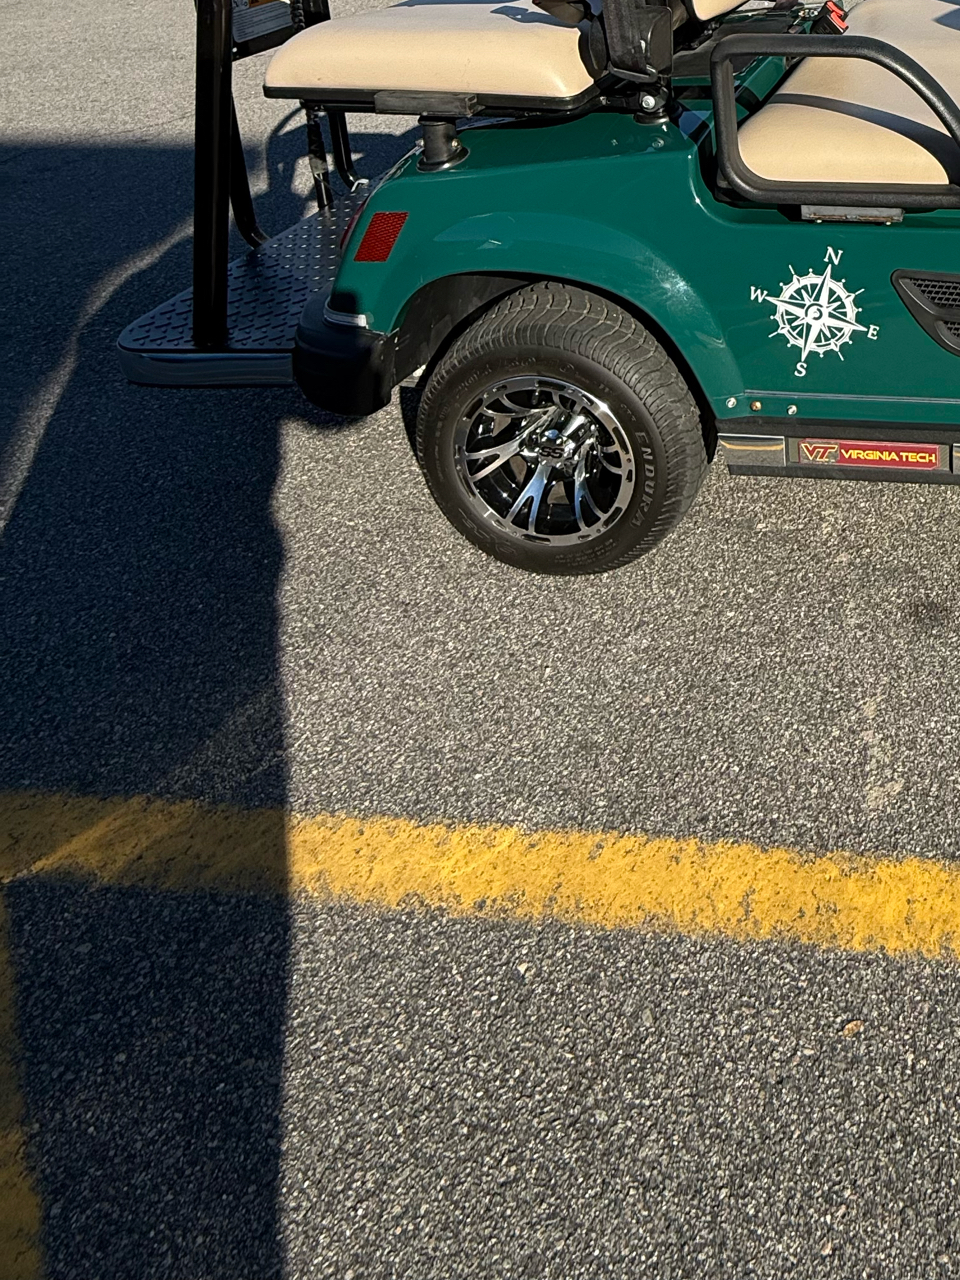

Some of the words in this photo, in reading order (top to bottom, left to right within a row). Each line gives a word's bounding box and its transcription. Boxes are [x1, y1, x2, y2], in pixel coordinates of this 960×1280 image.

[823, 246, 843, 266] N
[750, 286, 768, 303] W
[867, 324, 880, 340] E
[794, 362, 807, 377] S
[801, 443, 838, 461] VT
[841, 449, 899, 461] VIRGINIA
[900, 452, 936, 463] TECH
[633, 431, 655, 526] ENDURA
